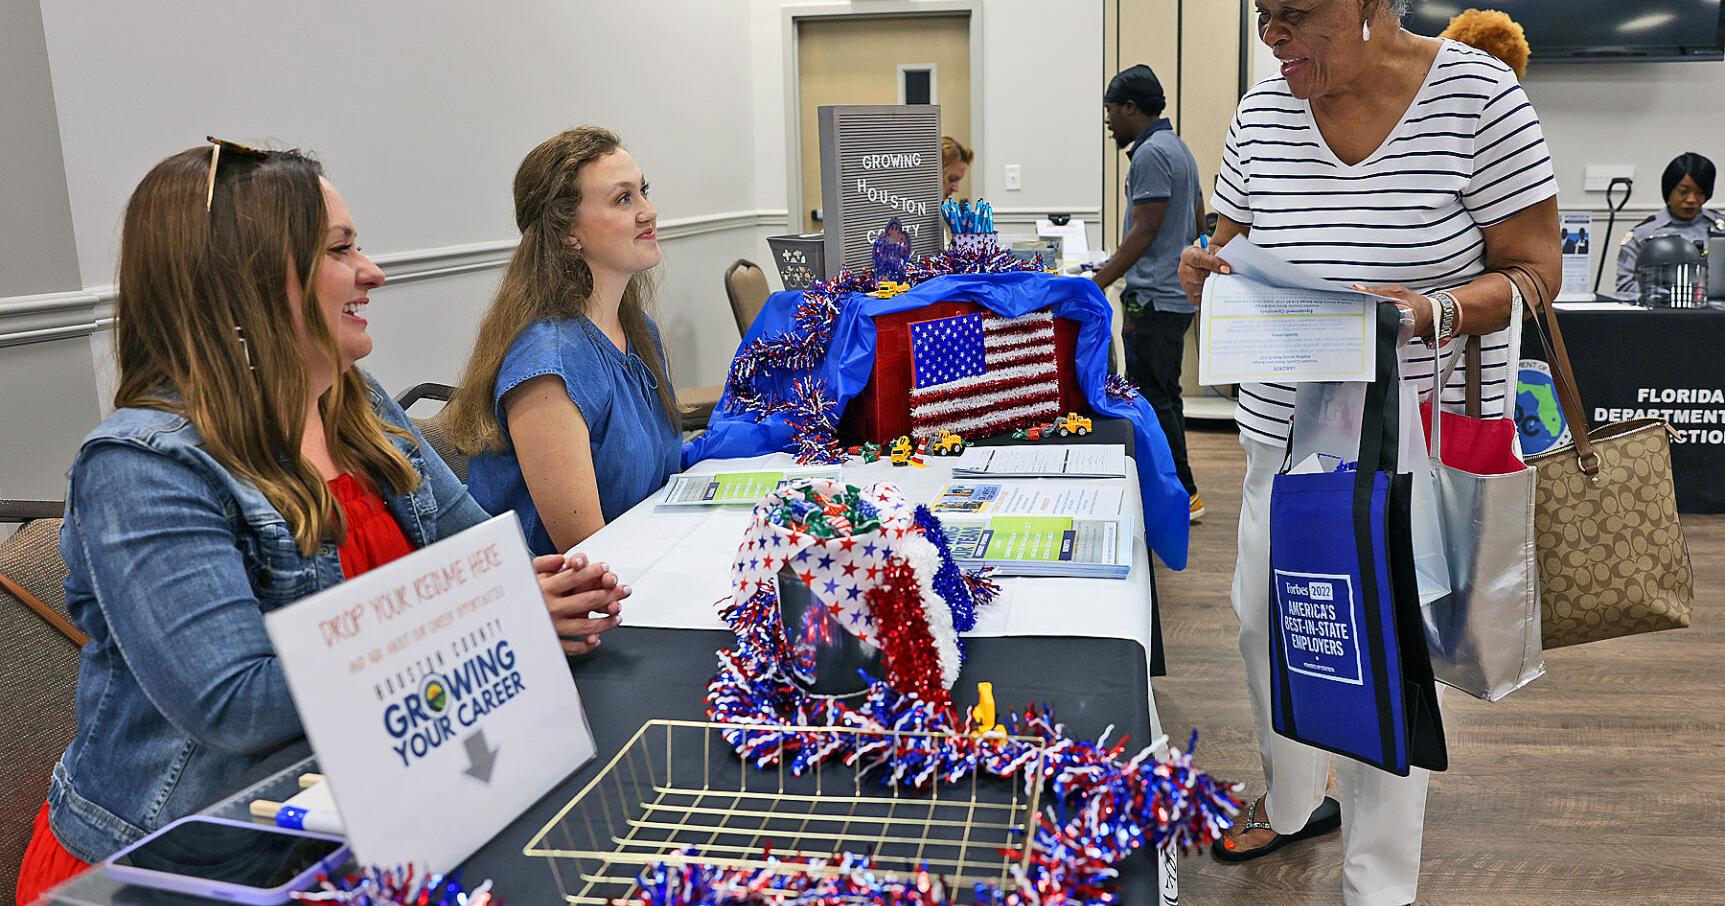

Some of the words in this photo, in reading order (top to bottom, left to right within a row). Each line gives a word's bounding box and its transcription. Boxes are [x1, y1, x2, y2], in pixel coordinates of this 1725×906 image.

[862, 153, 921, 169] GROWING
[857, 178, 926, 216] HOUSTON
[1637, 388, 1725, 404] FLORIDA
[1286, 582, 1309, 596] Forbes
[1311, 585, 1331, 597] 2022
[370, 584, 413, 624] YOUR
[1288, 600, 1336, 621] AMERICA'S
[1284, 616, 1350, 640] BEST-IN-STATE
[1291, 633, 1345, 656] EMPLOYERS
[383, 639, 516, 739] GROWING
[393, 714, 457, 767] YOUR
[457, 670, 526, 727] CAREER
